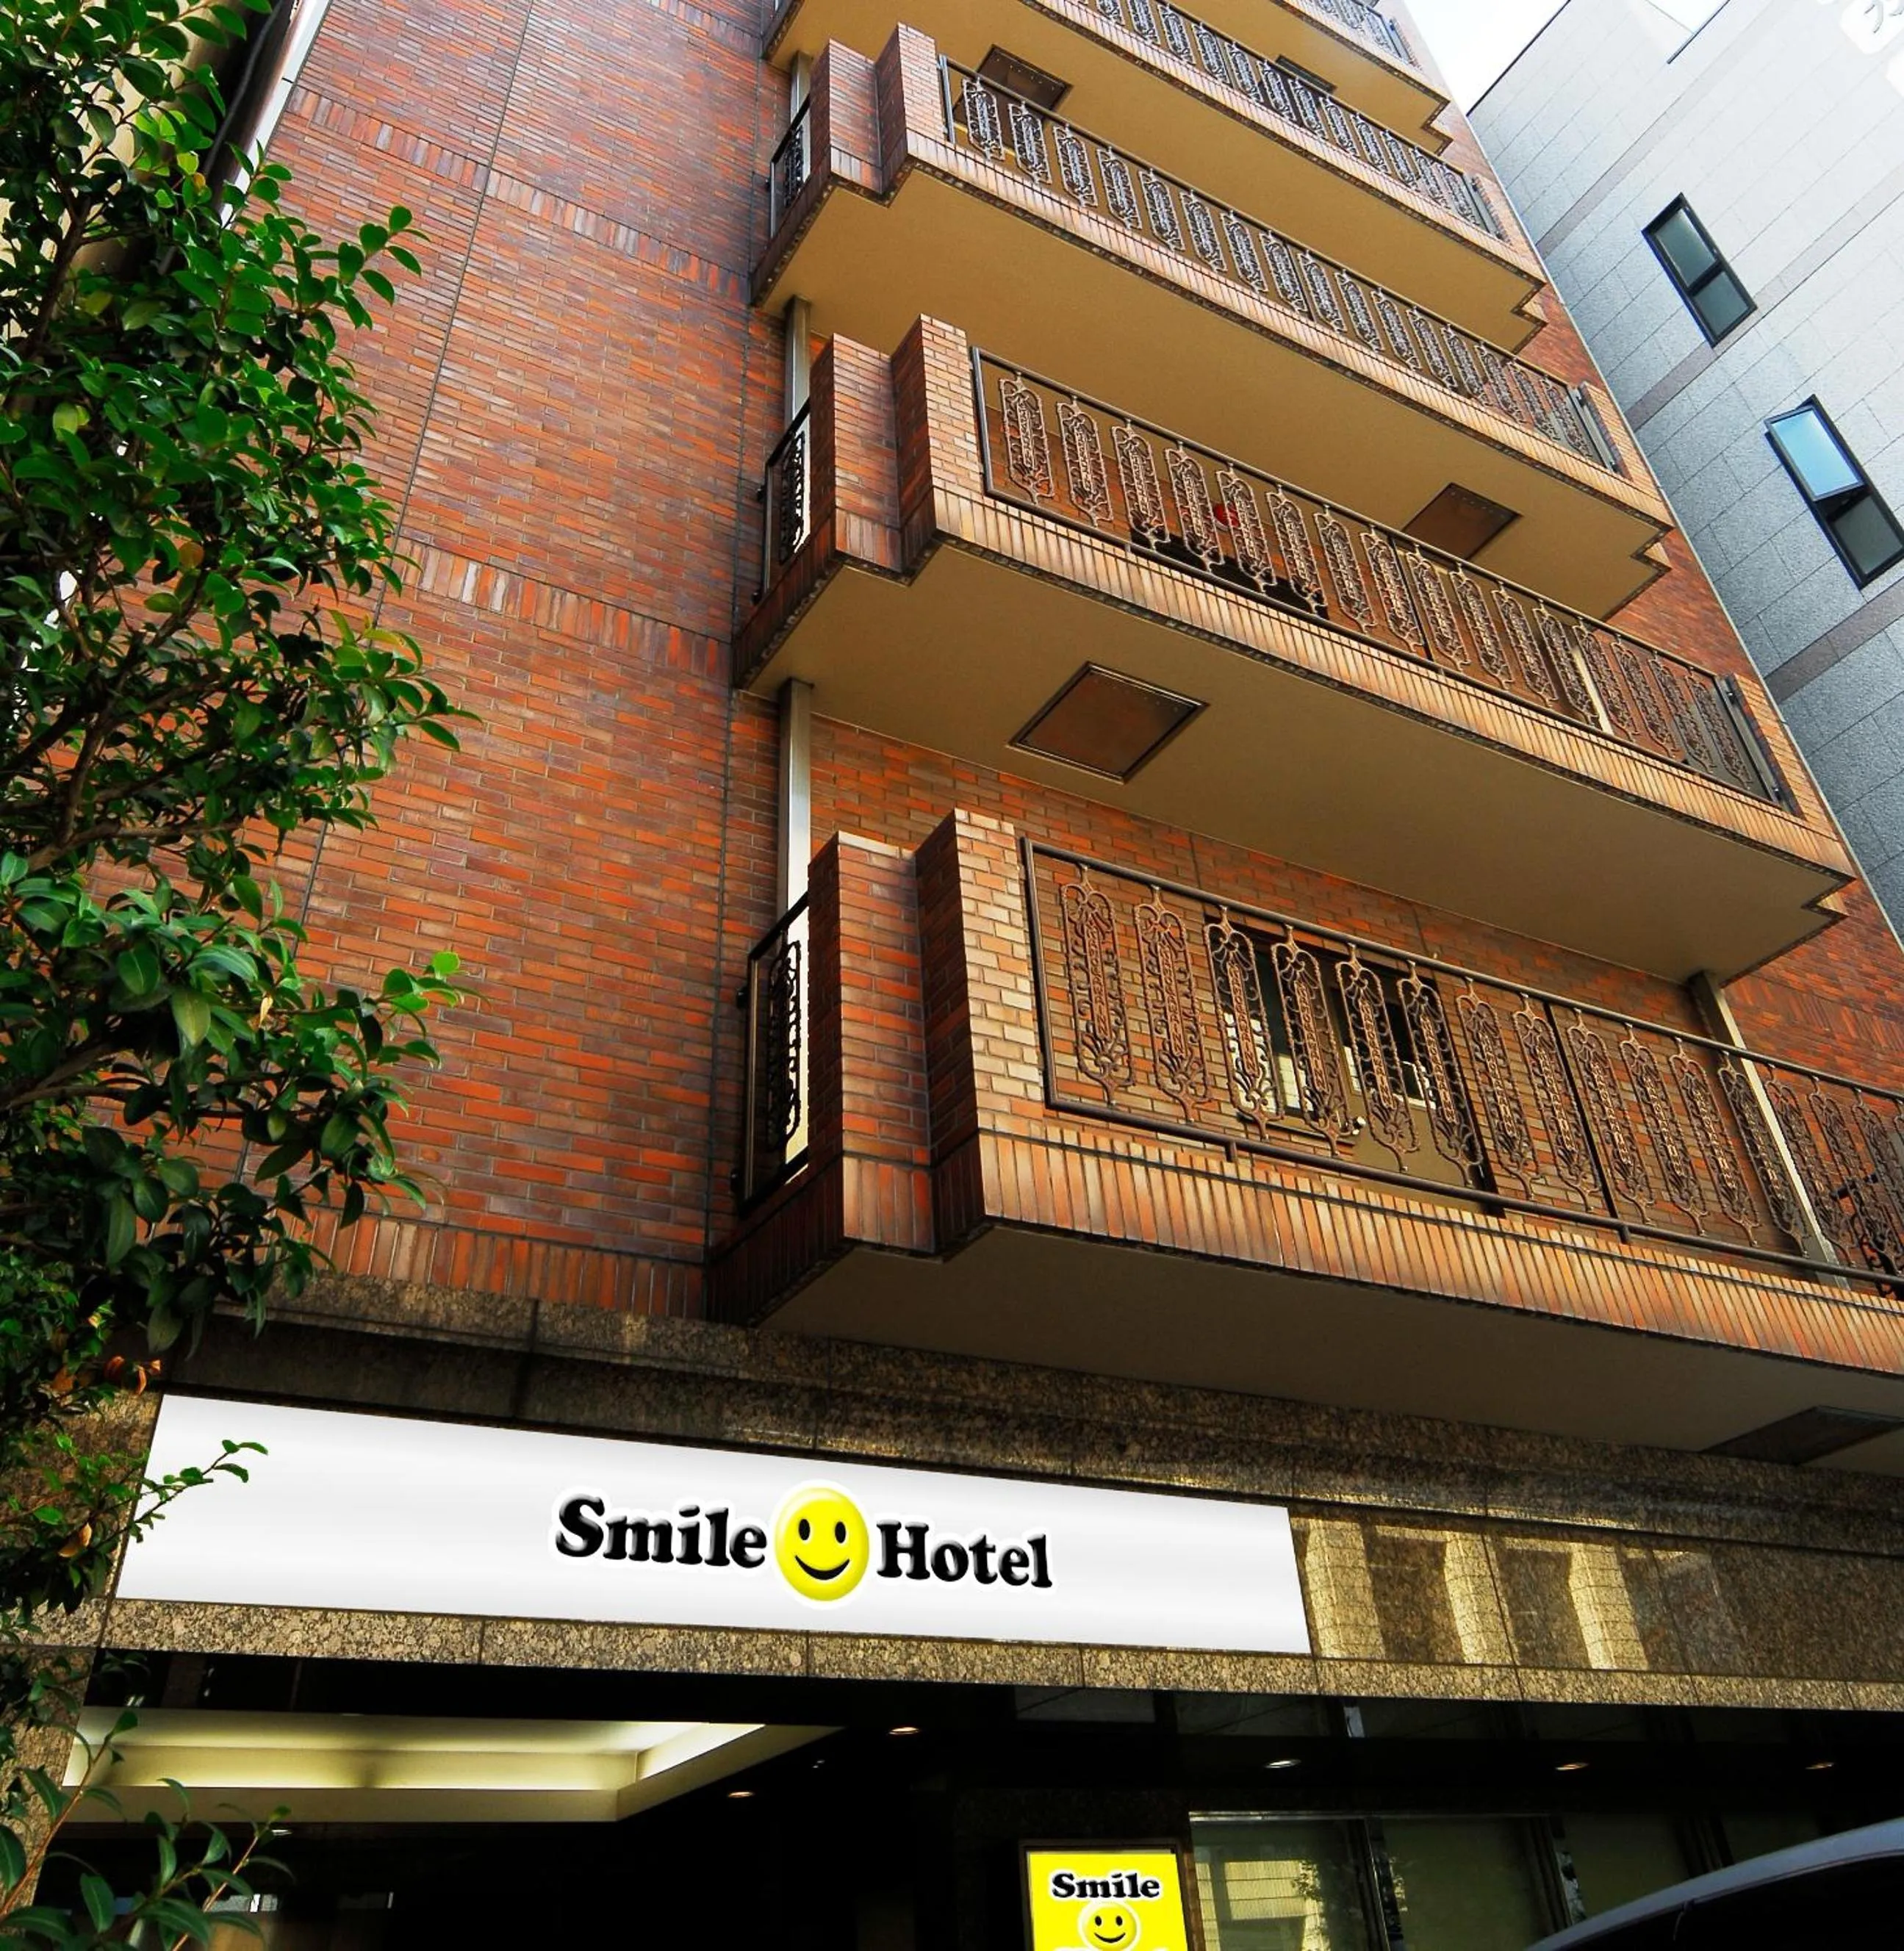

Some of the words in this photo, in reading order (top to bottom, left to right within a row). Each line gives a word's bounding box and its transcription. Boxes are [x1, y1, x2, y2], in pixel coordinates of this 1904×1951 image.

[556, 1493, 766, 1567] Smile
[877, 1520, 1052, 1587] Hotel
[1052, 1873, 1160, 1898] Smile
